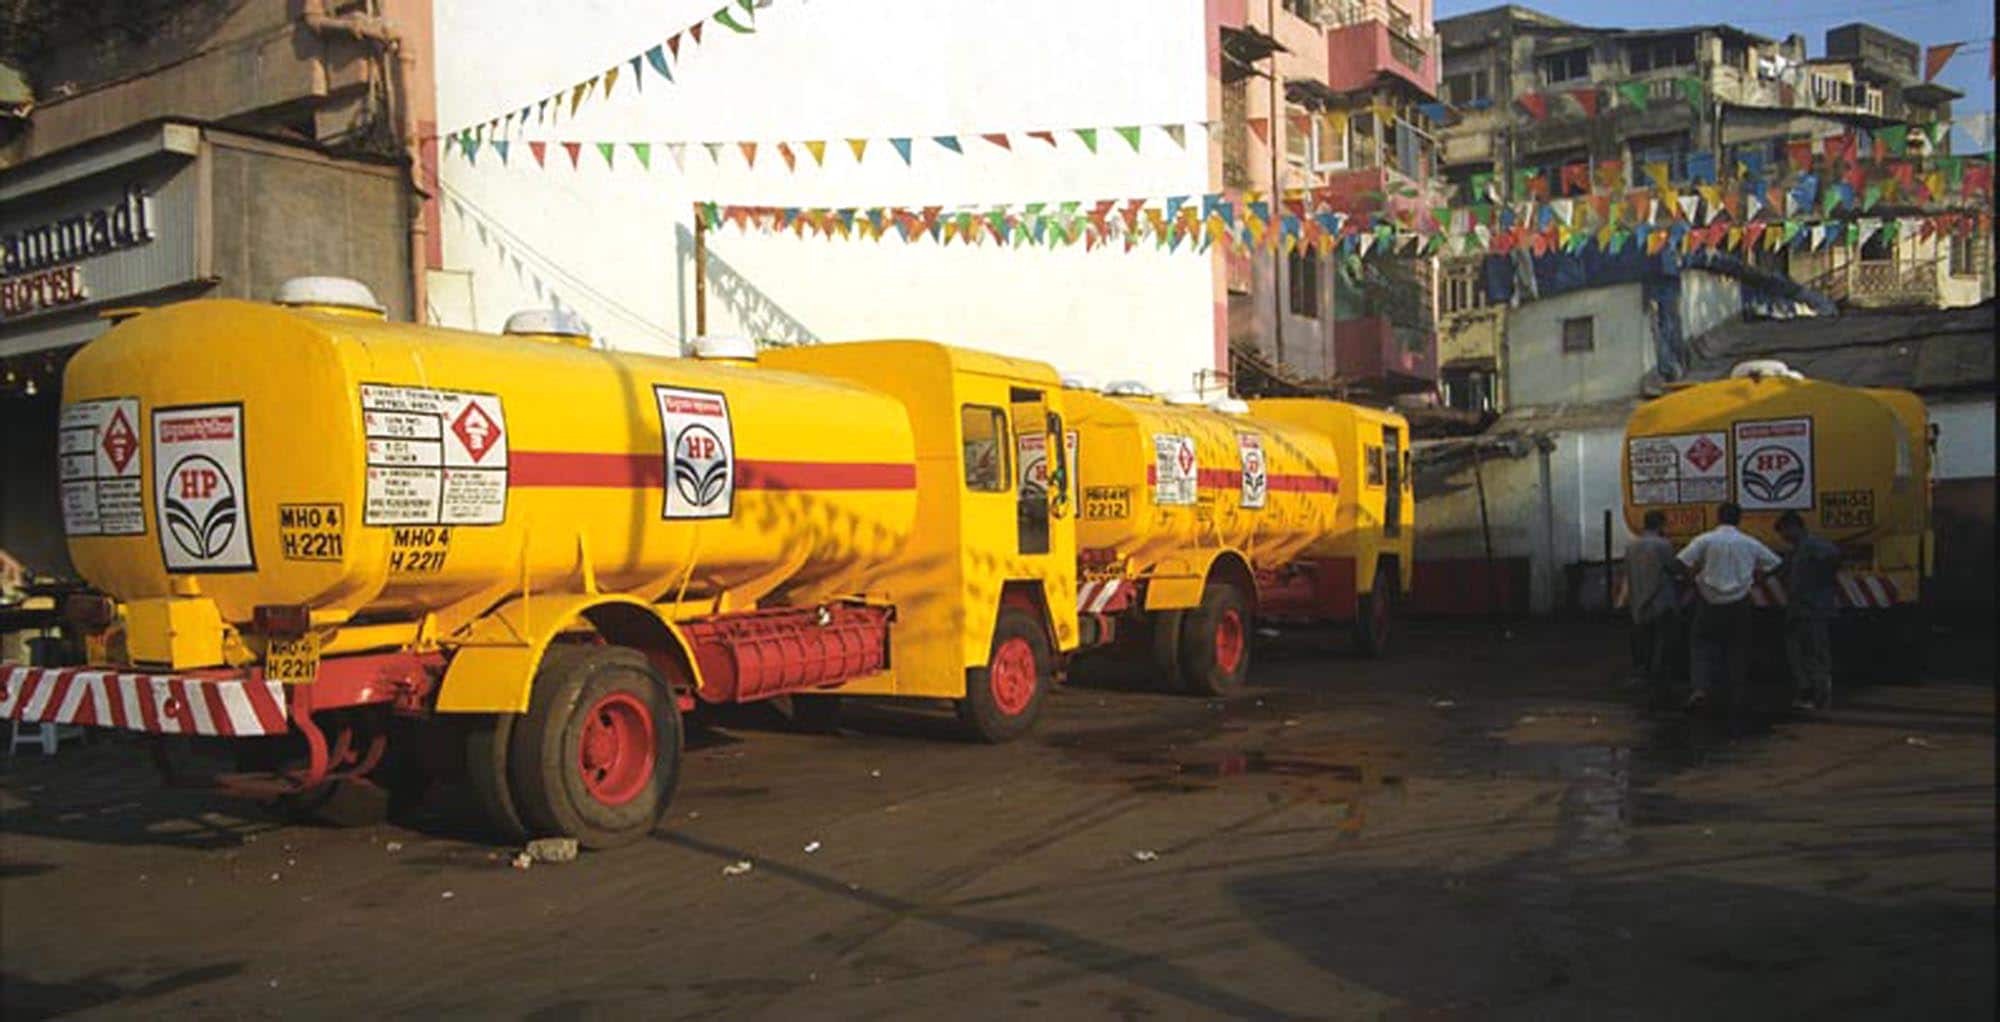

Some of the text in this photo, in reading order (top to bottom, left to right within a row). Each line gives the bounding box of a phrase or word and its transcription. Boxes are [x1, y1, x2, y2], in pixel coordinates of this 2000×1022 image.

[3, 266, 86, 316] HOTEL
[686, 436, 716, 459] HP
[1757, 454, 1792, 472] HP
[179, 470, 218, 499] HP
[1088, 503, 1124, 518] 2212
[300, 533, 343, 556] 2211
[406, 550, 447, 571] 2211
